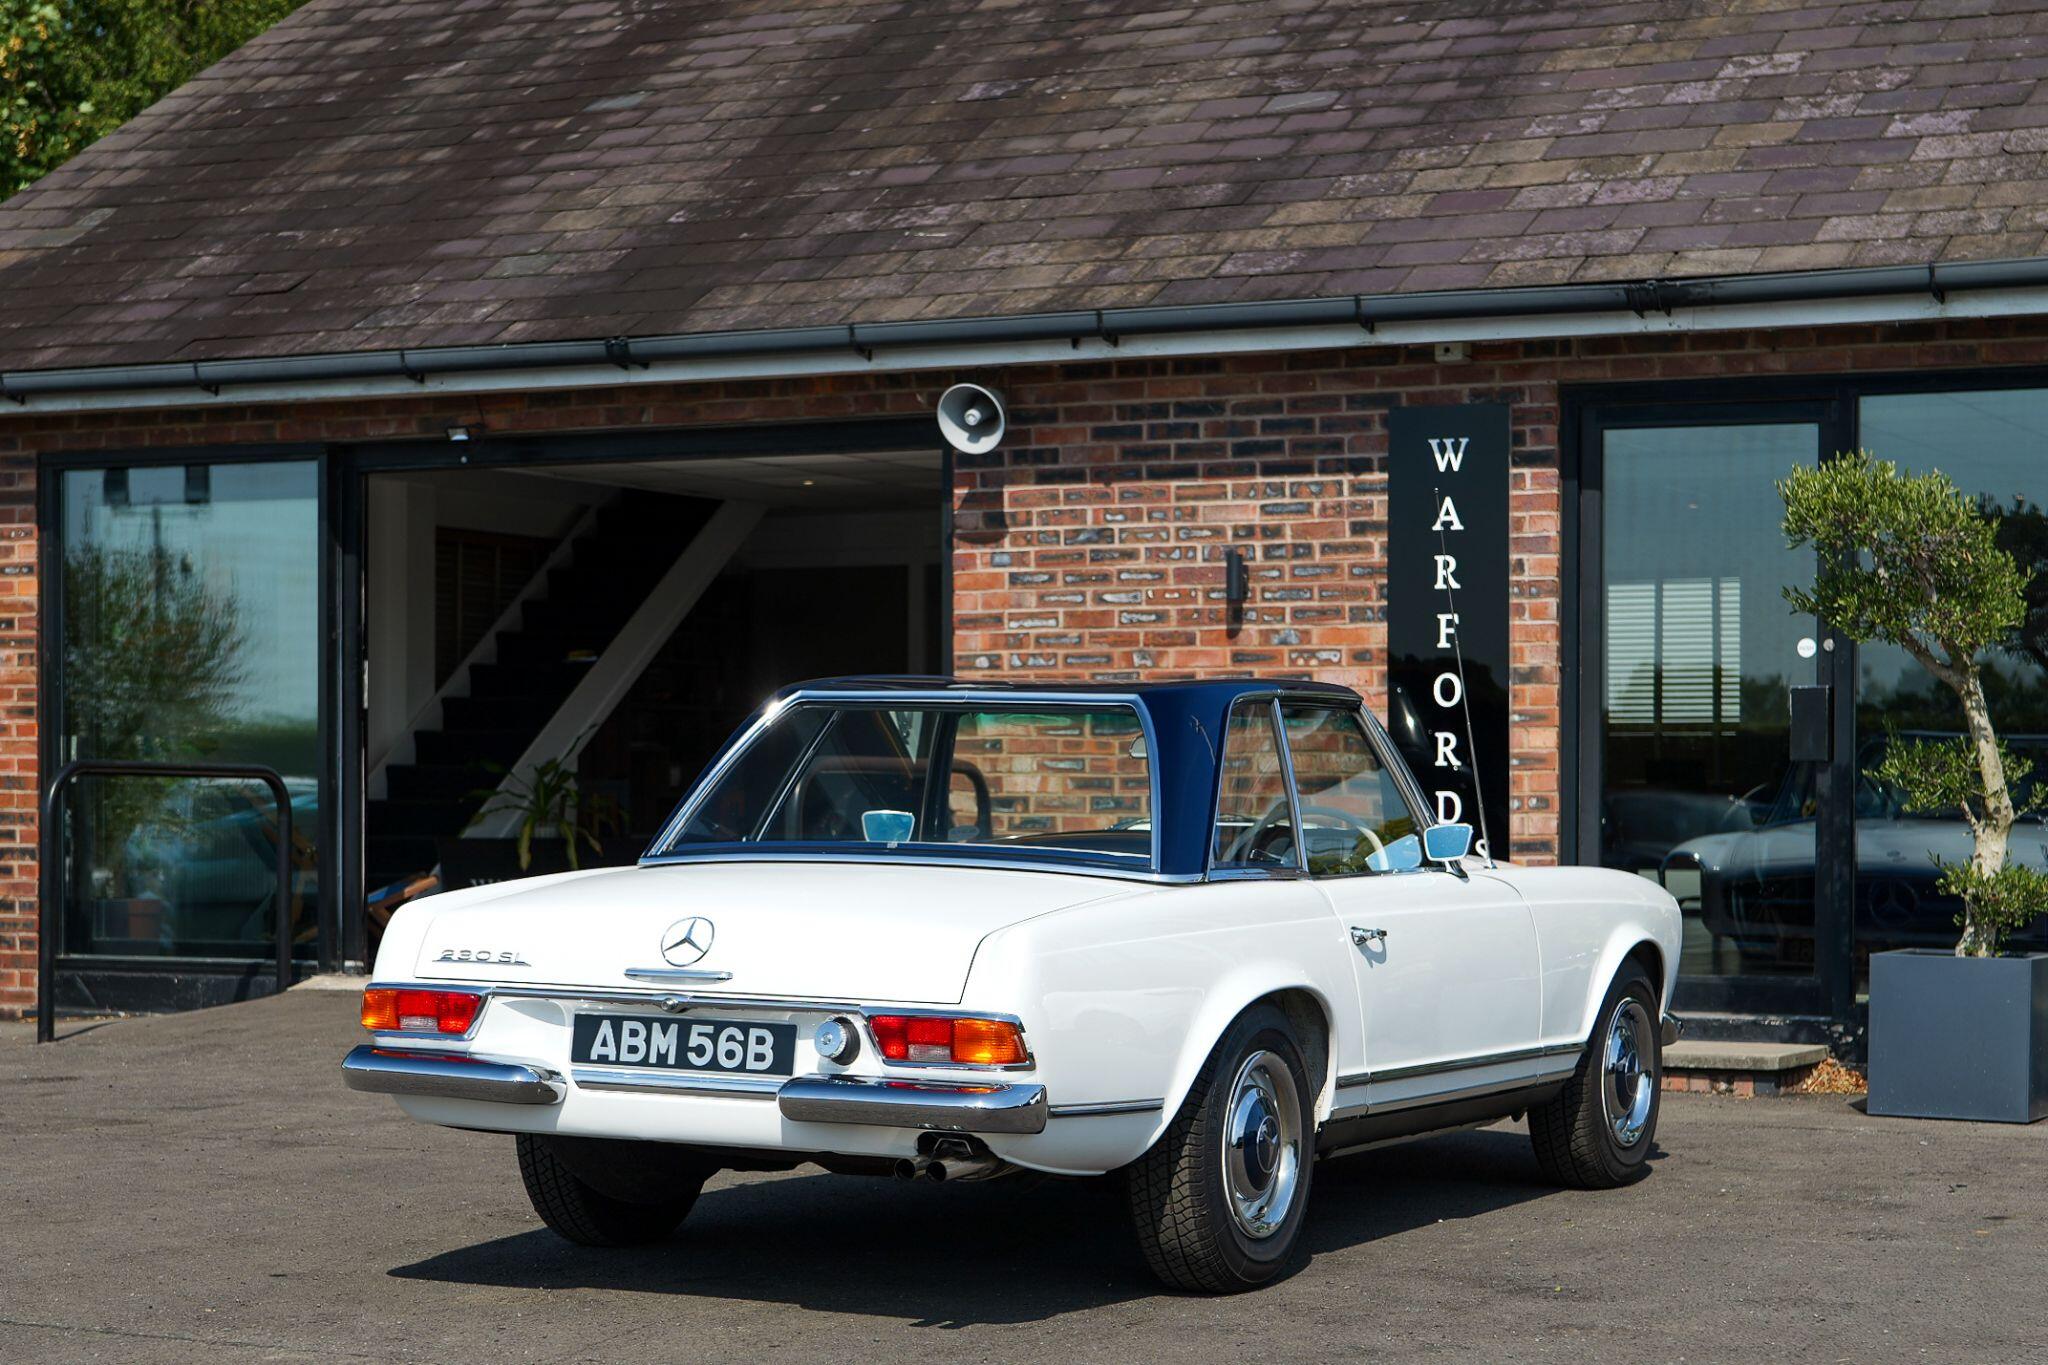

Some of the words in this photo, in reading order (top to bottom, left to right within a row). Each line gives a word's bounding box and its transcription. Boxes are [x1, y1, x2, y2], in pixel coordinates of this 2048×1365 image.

[440, 949, 492, 961] 230
[498, 951, 527, 964] SL
[590, 1019, 679, 1065] ABM
[686, 1024, 774, 1071] 56B
